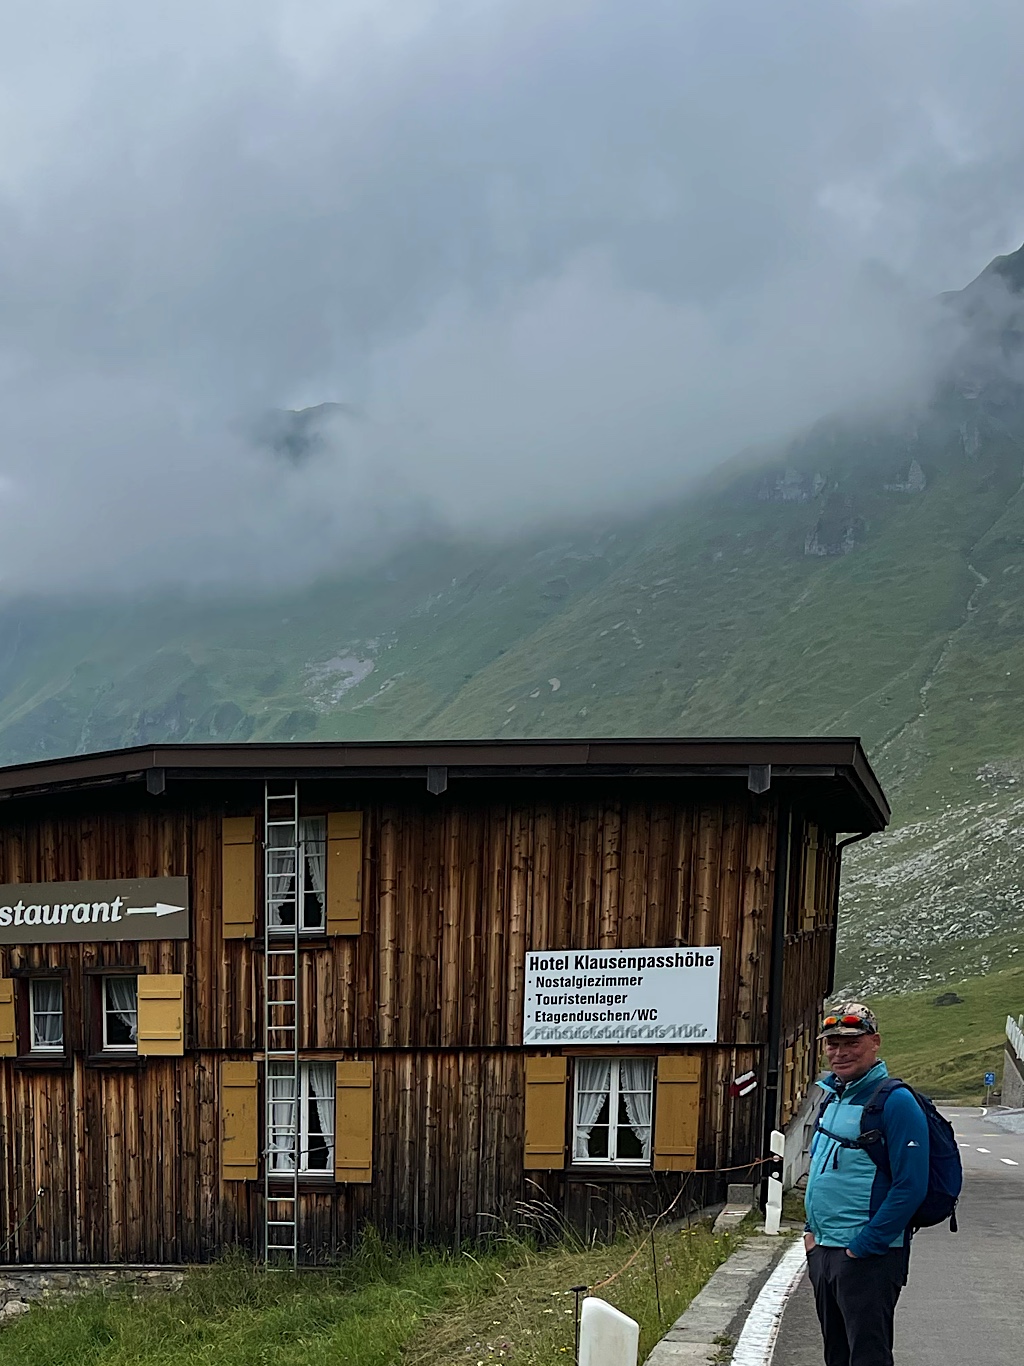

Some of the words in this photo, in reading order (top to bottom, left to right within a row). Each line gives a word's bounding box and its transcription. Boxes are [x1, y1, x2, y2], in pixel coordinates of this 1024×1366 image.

[529, 955, 569, 971] Hotel
[574, 951, 715, 971] Klausenpasshöhe
[535, 975, 644, 989] Nostalgiezimmer
[535, 992, 628, 1006] Touristenlager
[534, 1008, 658, 1024] Etagenduschen/WC
